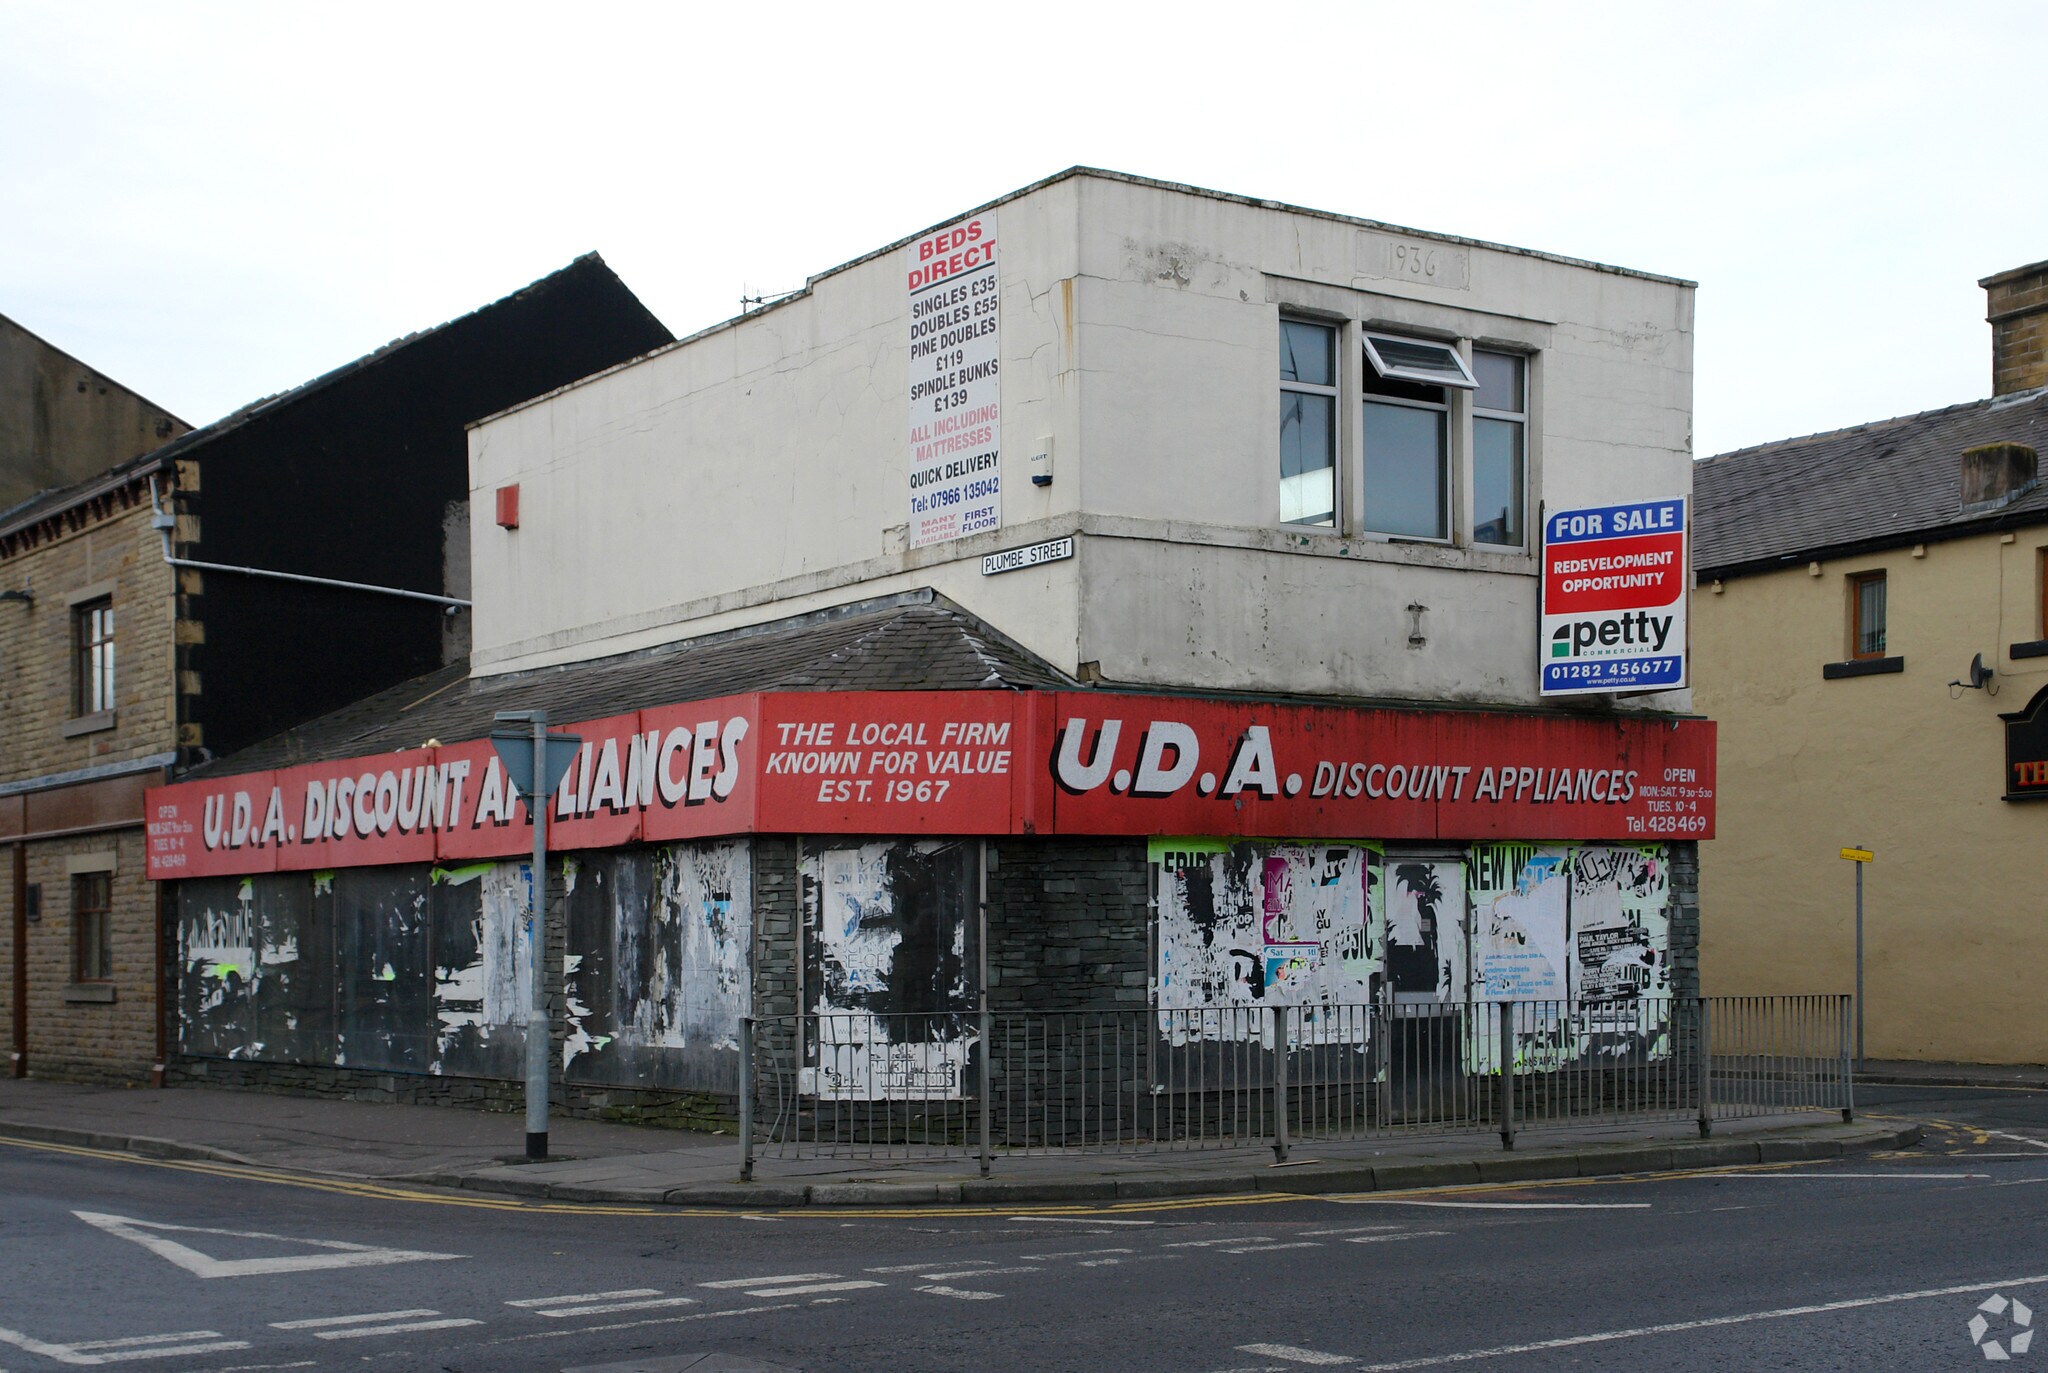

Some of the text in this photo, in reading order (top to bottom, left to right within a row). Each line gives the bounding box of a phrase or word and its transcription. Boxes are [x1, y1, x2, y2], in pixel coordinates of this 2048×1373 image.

[920, 220, 982, 262] BEDS
[908, 239, 996, 291] DIRECT
[1389, 243, 1435, 276] 1936
[913, 278, 996, 319] SINGLES £35
[910, 295, 998, 341] DOUBLES £55
[910, 318, 996, 360] PINE DOUBLES
[936, 350, 964, 372] £119
[910, 359, 998, 401] SPINDLE BUNKS
[934, 389, 968, 413] £139
[910, 403, 998, 445] ALL INCLUDING
[916, 427, 992, 463] MATTRESSES
[910, 451, 999, 489] QUICK DELIVERY
[911, 476, 999, 514] Tel: 07966 135042
[921, 513, 956, 528] MANY
[962, 518, 996, 533] FLOOR
[964, 506, 994, 521] FIRST
[1556, 506, 1674, 538] FOR SALE
[916, 529, 960, 546] AVAILABLE
[921, 522, 955, 536] MORE
[985, 540, 1068, 572] PLUMBE STREET
[1554, 551, 1674, 575] REDEVELOPMENT
[1562, 572, 1665, 593] OPPORTUNITY
[1573, 611, 1674, 657] petty
[1583, 647, 1650, 657] COMMERCIAL
[1551, 660, 1673, 680] 01282 456677
[1586, 676, 1637, 686] www.petty.co.uk
[777, 723, 1011, 746] THE LOCAL FIRM
[765, 751, 1012, 775] KNOWN FOR VALUE
[1057, 717, 1639, 802] U.D.A. DISCOUNT APPLIANCES
[1664, 768, 1696, 783] OPEN
[817, 780, 950, 802] EST. 1967
[159, 805, 177, 819] OPEN
[203, 786, 295, 849] U.D.A.
[303, 759, 471, 839] DISCOUNT
[1648, 800, 1673, 812] TUES.
[1626, 816, 1706, 833] Tel. 428469
[1466, 846, 1506, 891] NEW
[1595, 931, 1619, 941] TAYLOR
